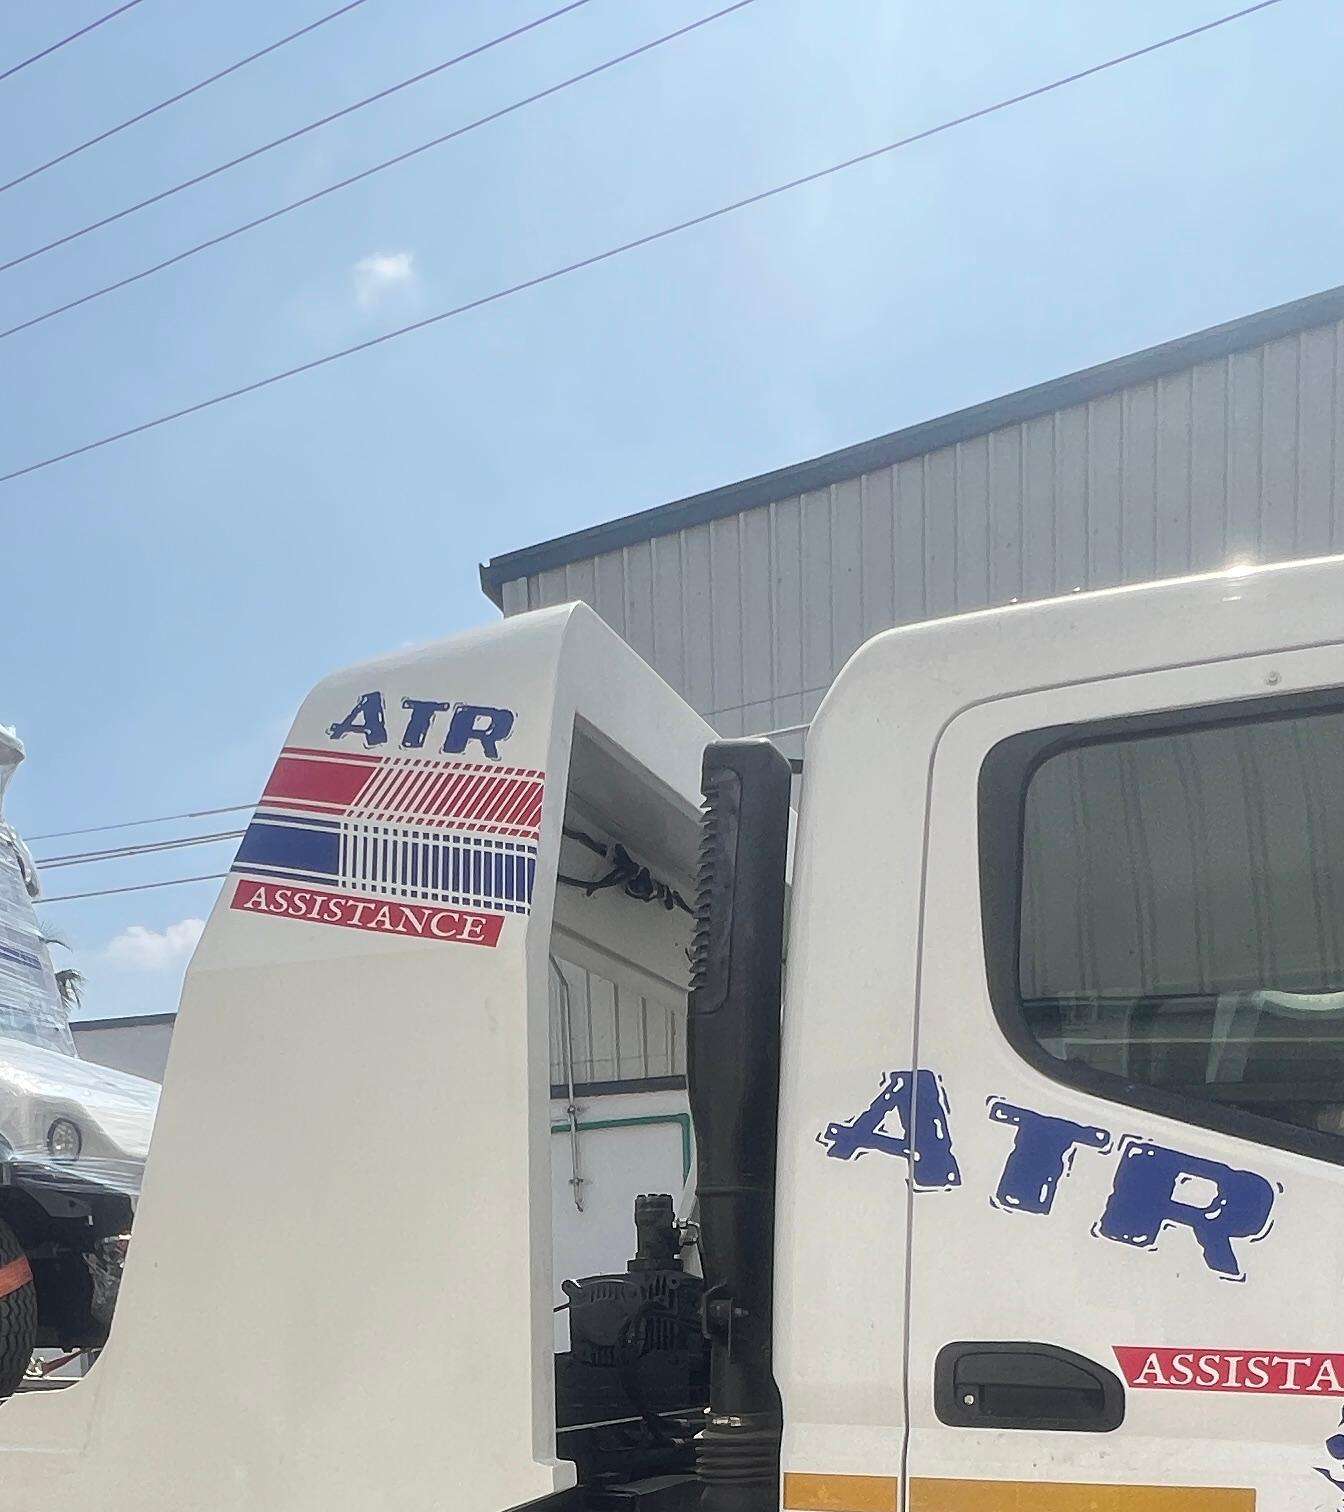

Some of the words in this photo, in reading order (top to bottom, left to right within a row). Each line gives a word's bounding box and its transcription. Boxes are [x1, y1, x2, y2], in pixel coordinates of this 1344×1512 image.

[325, 690, 518, 761] ATR
[243, 885, 488, 942] ASSISTANCE
[816, 1068, 1284, 1282] ATR
